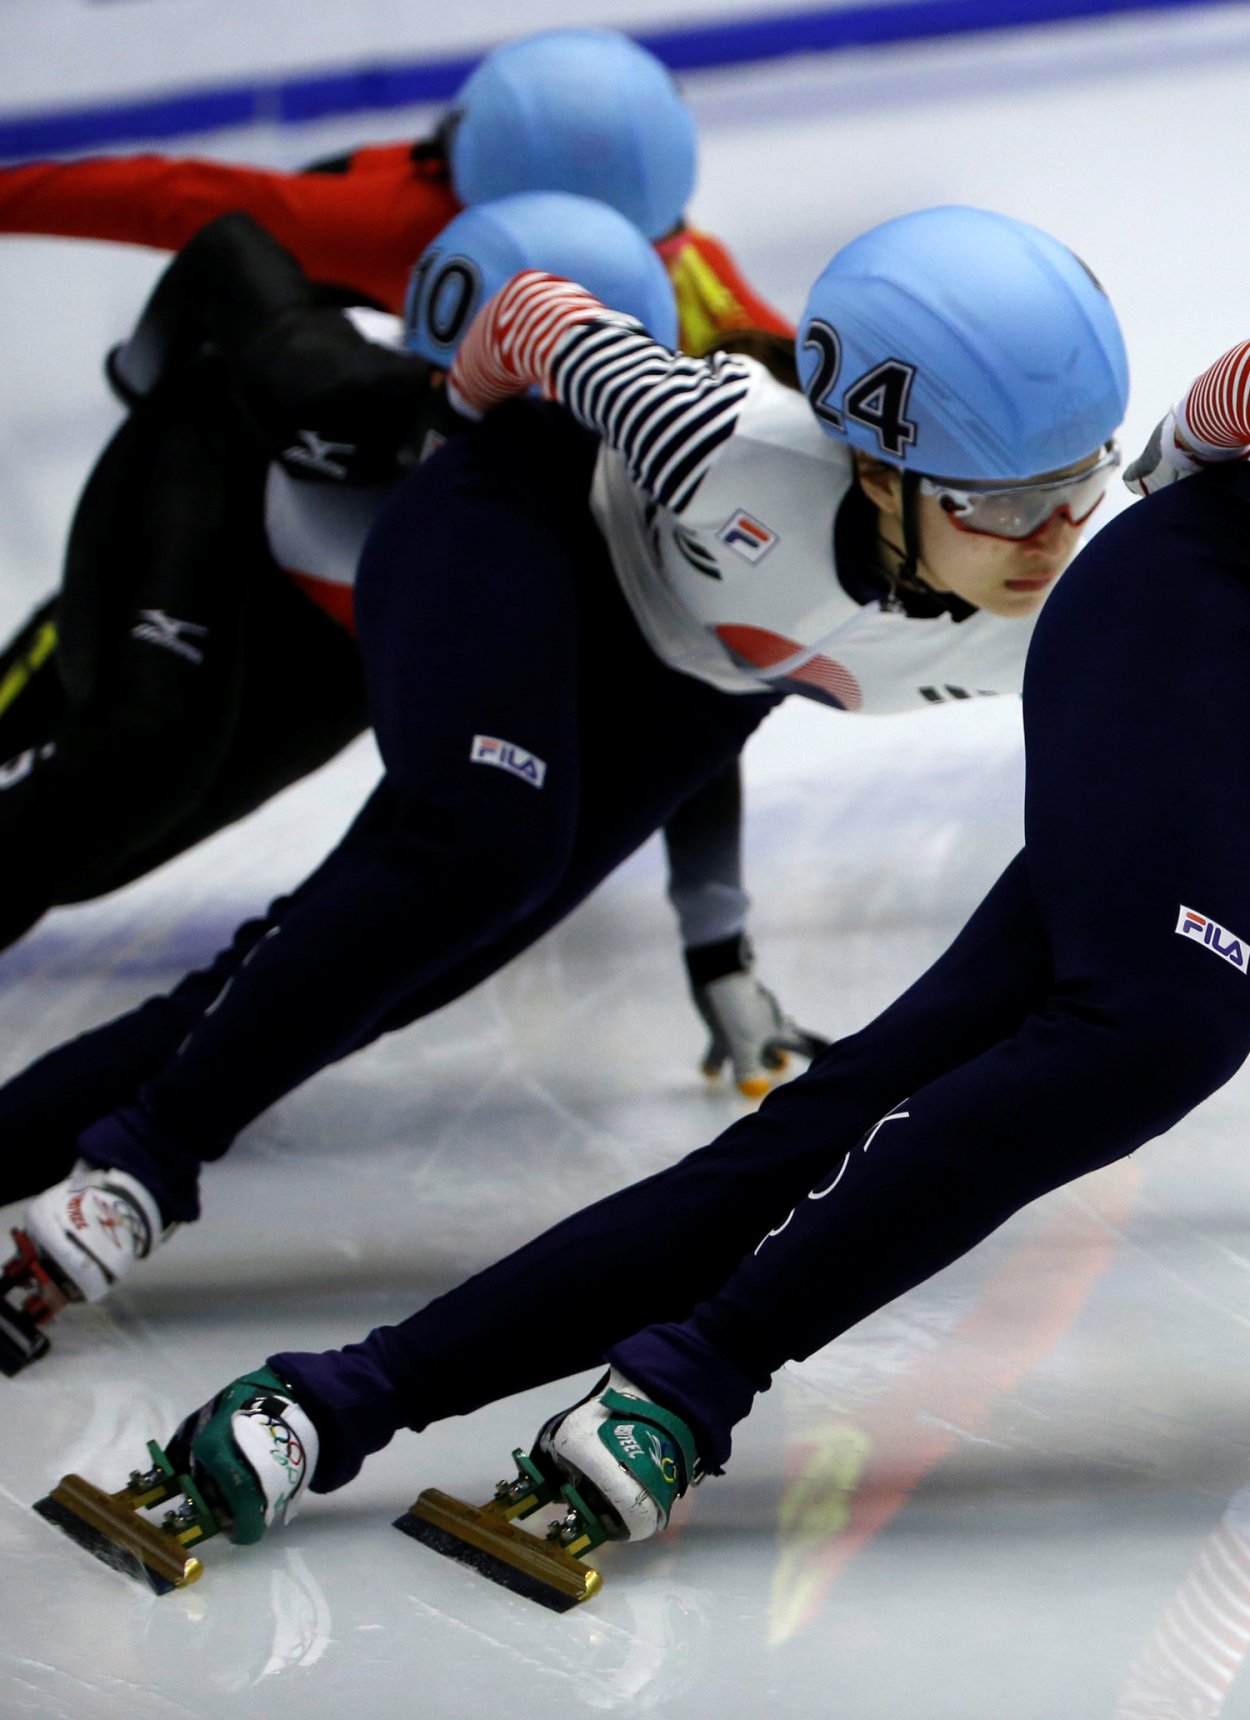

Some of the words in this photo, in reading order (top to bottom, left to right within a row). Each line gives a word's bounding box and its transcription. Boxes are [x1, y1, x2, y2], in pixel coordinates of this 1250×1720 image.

[408, 248, 484, 350] 10
[803, 317, 918, 461] 24
[478, 739, 539, 780] FILA
[1182, 911, 1244, 967] FILA
